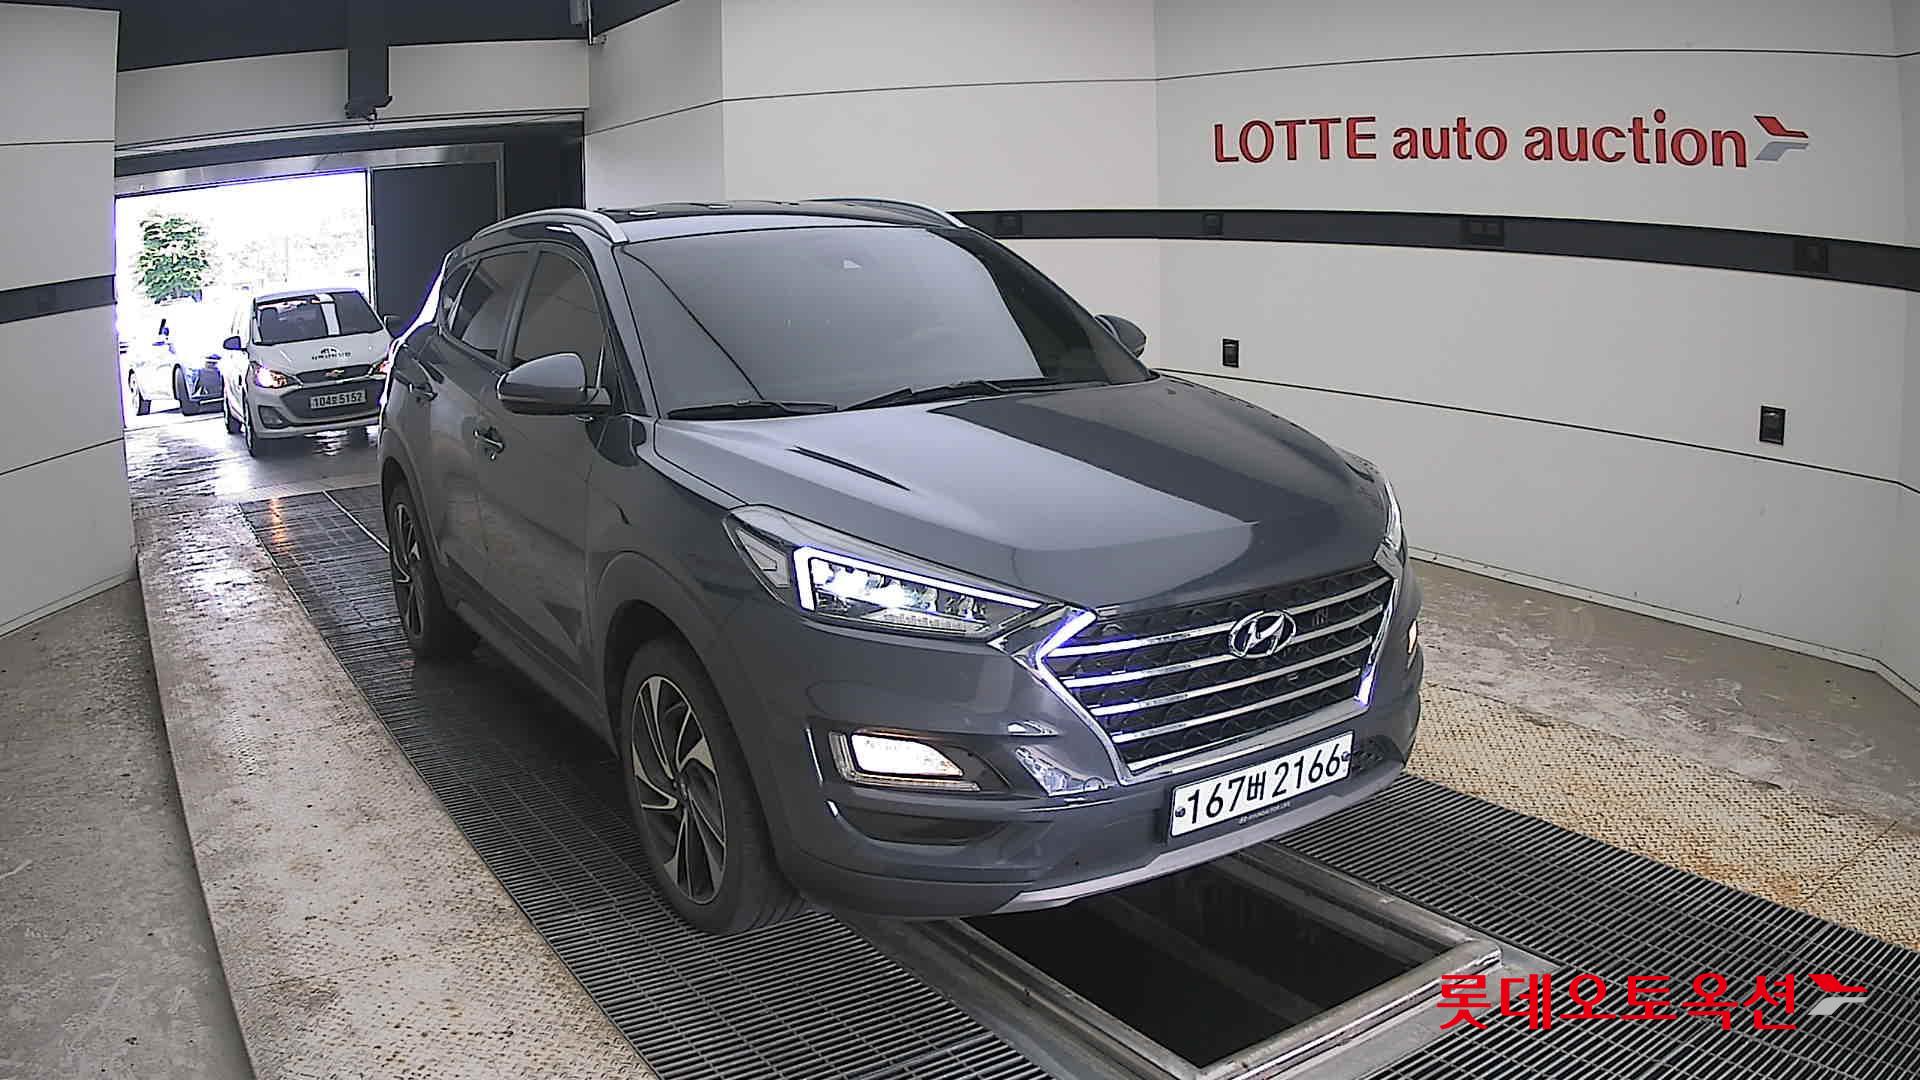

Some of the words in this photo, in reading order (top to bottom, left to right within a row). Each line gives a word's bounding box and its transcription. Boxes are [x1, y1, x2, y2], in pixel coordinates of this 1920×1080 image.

[1214, 116, 1377, 163] LOTTE
[1392, 117, 1509, 161] auto
[1522, 109, 1748, 168] auction
[1187, 770, 1267, 824] 167버
[1271, 743, 1341, 798] 2166
